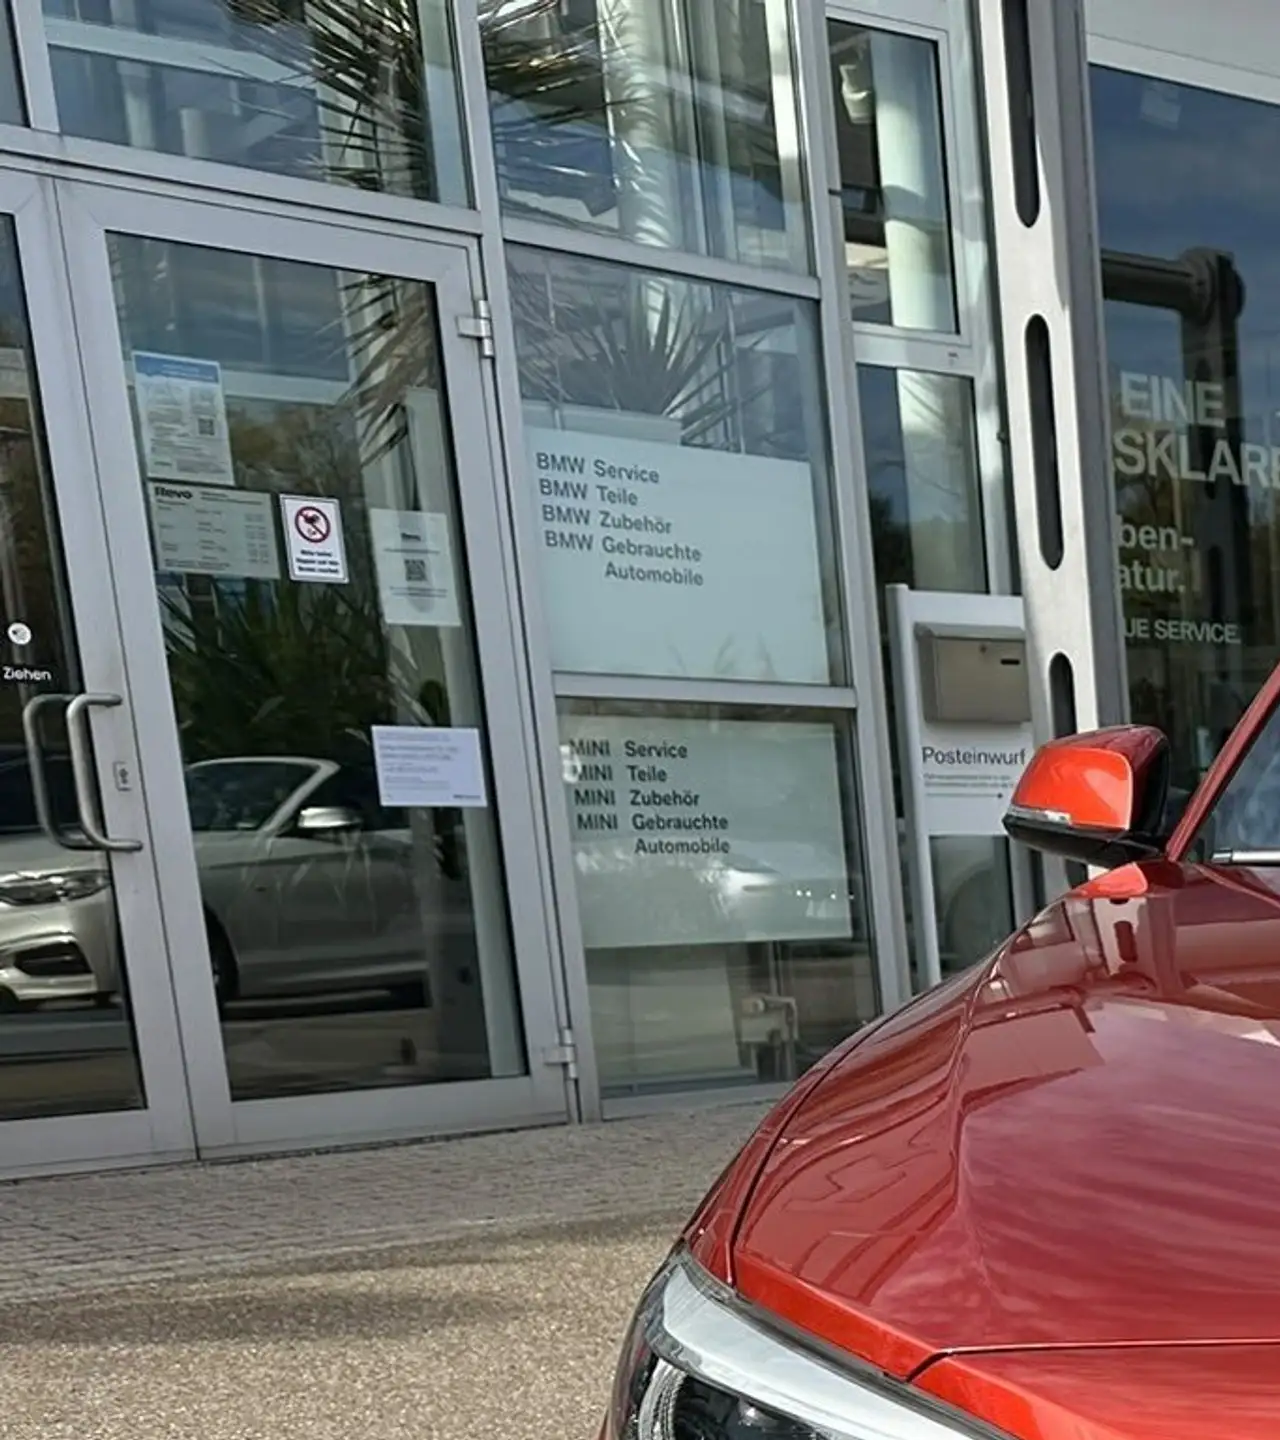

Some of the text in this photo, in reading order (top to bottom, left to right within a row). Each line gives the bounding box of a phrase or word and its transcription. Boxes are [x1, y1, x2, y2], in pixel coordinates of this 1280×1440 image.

[1121, 371, 1225, 428] EINE
[536, 452, 659, 484] BMW Service
[539, 478, 638, 506] BMW Teile
[542, 504, 672, 534] BMW Zubehör
[545, 530, 702, 562] BMW Gebrauchte
[604, 561, 703, 586] Automobile
[3, 666, 51, 681] Ziehen
[569, 739, 688, 759] MINI Service
[922, 746, 1025, 765] Posteinwurf
[626, 765, 667, 782] Teile
[574, 789, 700, 806] MINI Zubehör
[577, 813, 729, 830] MINI Gebrauchte
[634, 838, 731, 854] Automobile
